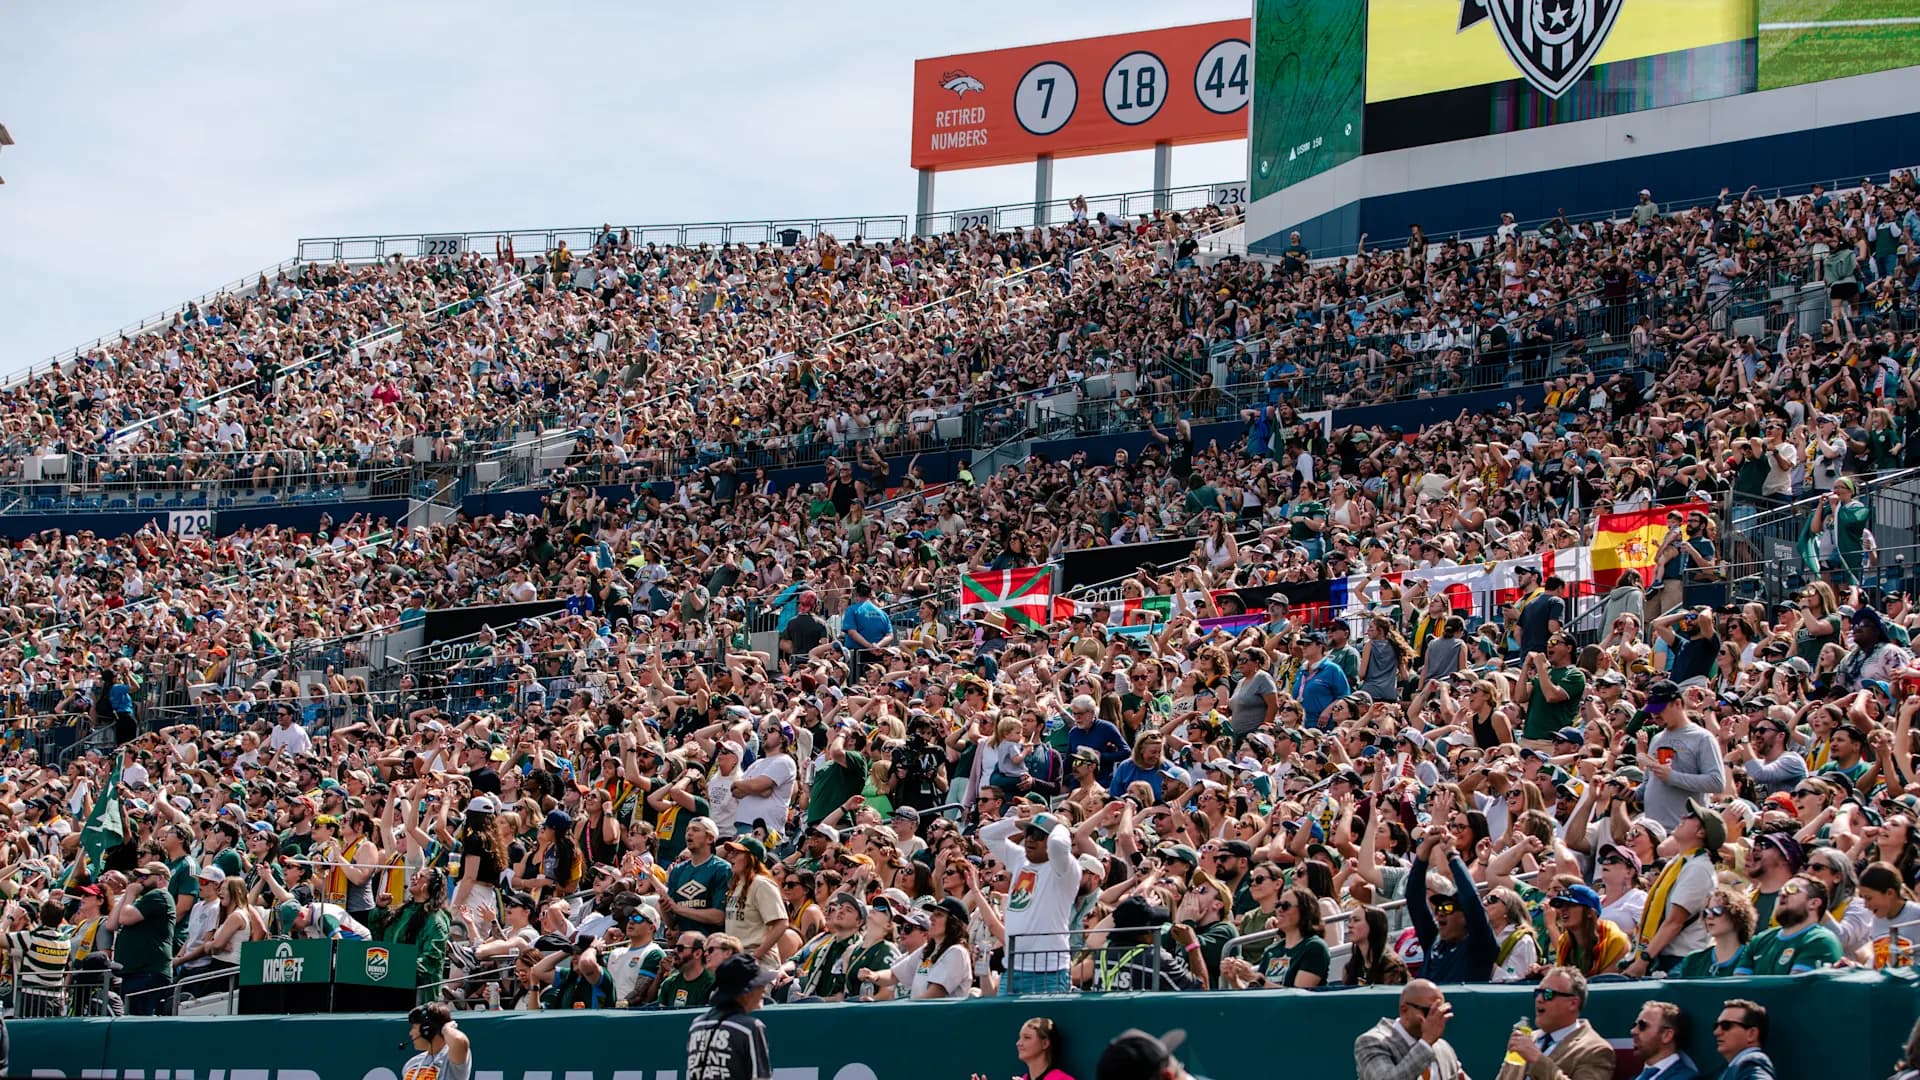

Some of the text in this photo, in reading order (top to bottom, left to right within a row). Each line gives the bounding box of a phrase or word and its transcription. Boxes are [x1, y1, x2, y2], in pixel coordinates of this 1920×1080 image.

[1204, 54, 1249, 98] 44
[1036, 77, 1055, 119] 7
[1116, 66, 1156, 110] 18
[935, 106, 986, 128] RETIRED
[931, 128, 988, 151] NUMBERS
[428, 240, 457, 255] 228
[173, 515, 208, 535] 129
